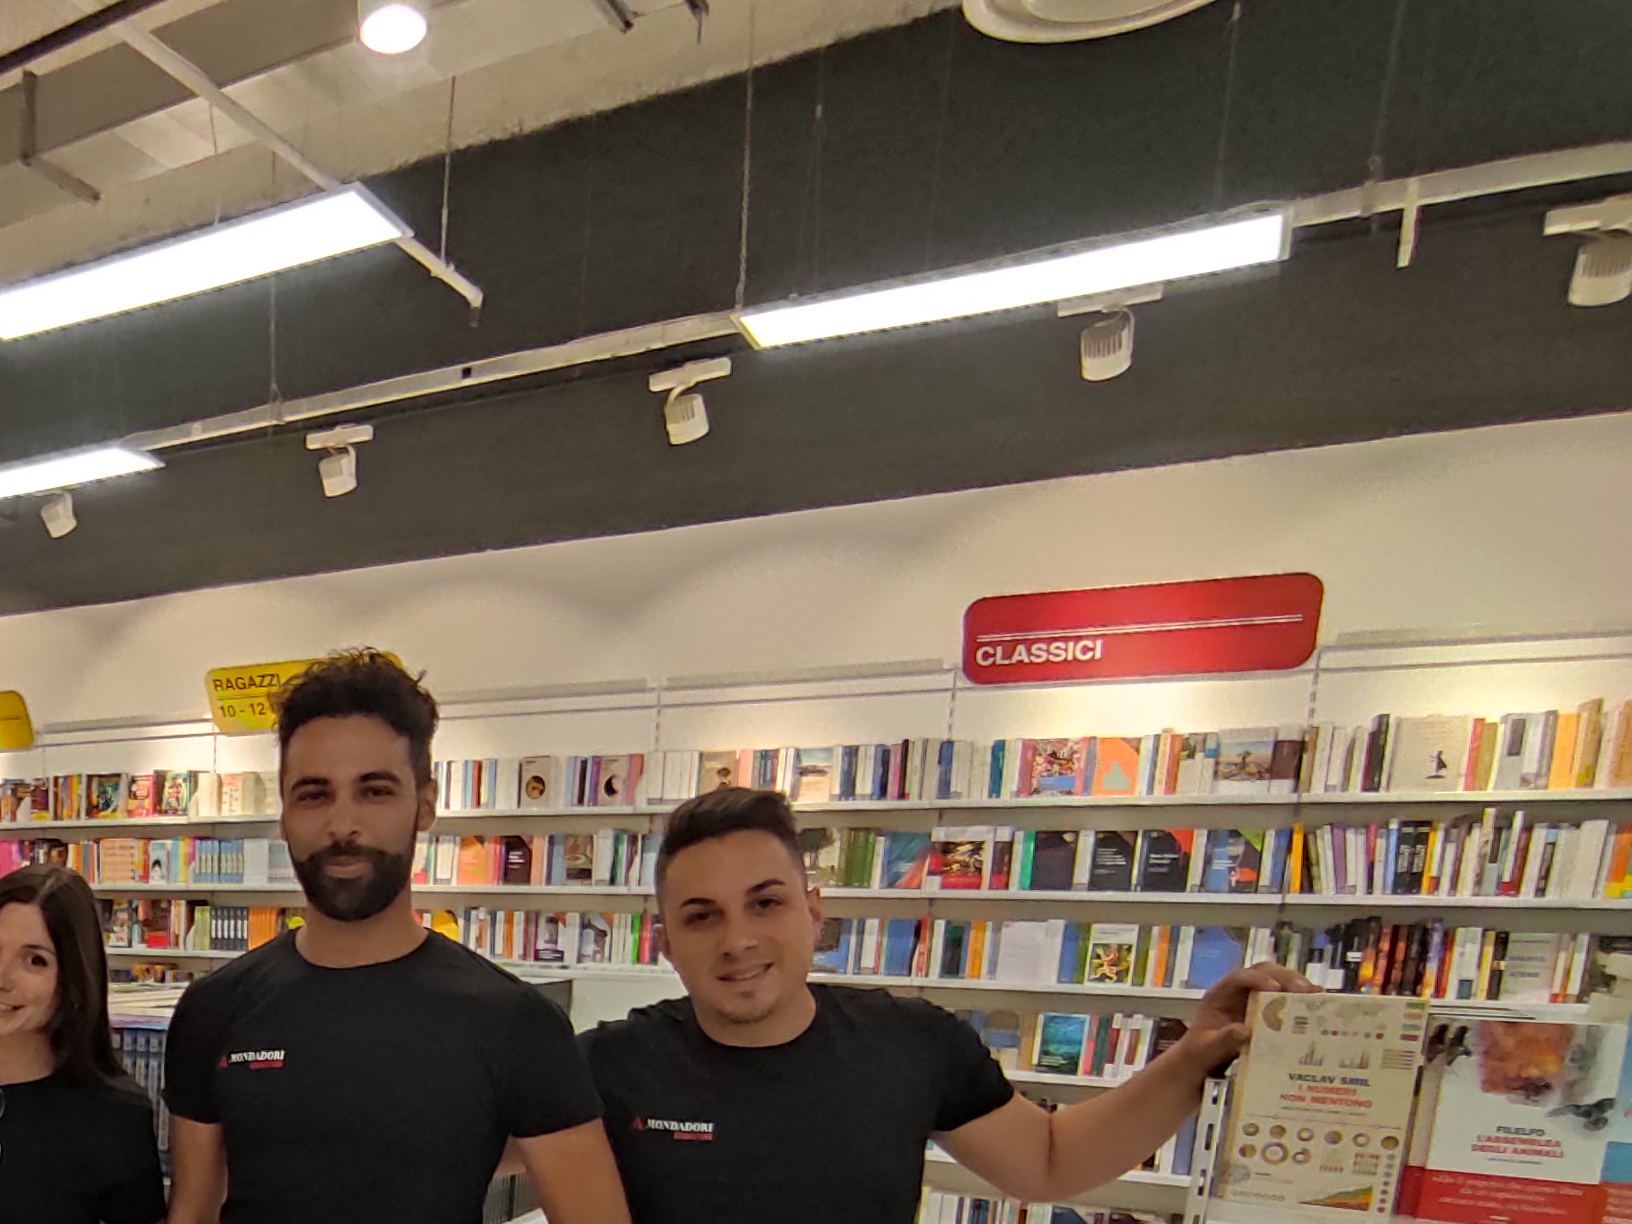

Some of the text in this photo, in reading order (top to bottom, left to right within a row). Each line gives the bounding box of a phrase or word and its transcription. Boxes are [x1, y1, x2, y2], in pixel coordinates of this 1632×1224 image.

[976, 639, 1103, 666] CLASSICI
[213, 674, 281, 692] RAGAZZI
[220, 705, 236, 718] 10
[251, 703, 266, 716] 12
[229, 1049, 285, 1063] MONDADORI
[1288, 1073, 1336, 1084] VACLAV
[646, 1119, 714, 1132] MONDADORI
